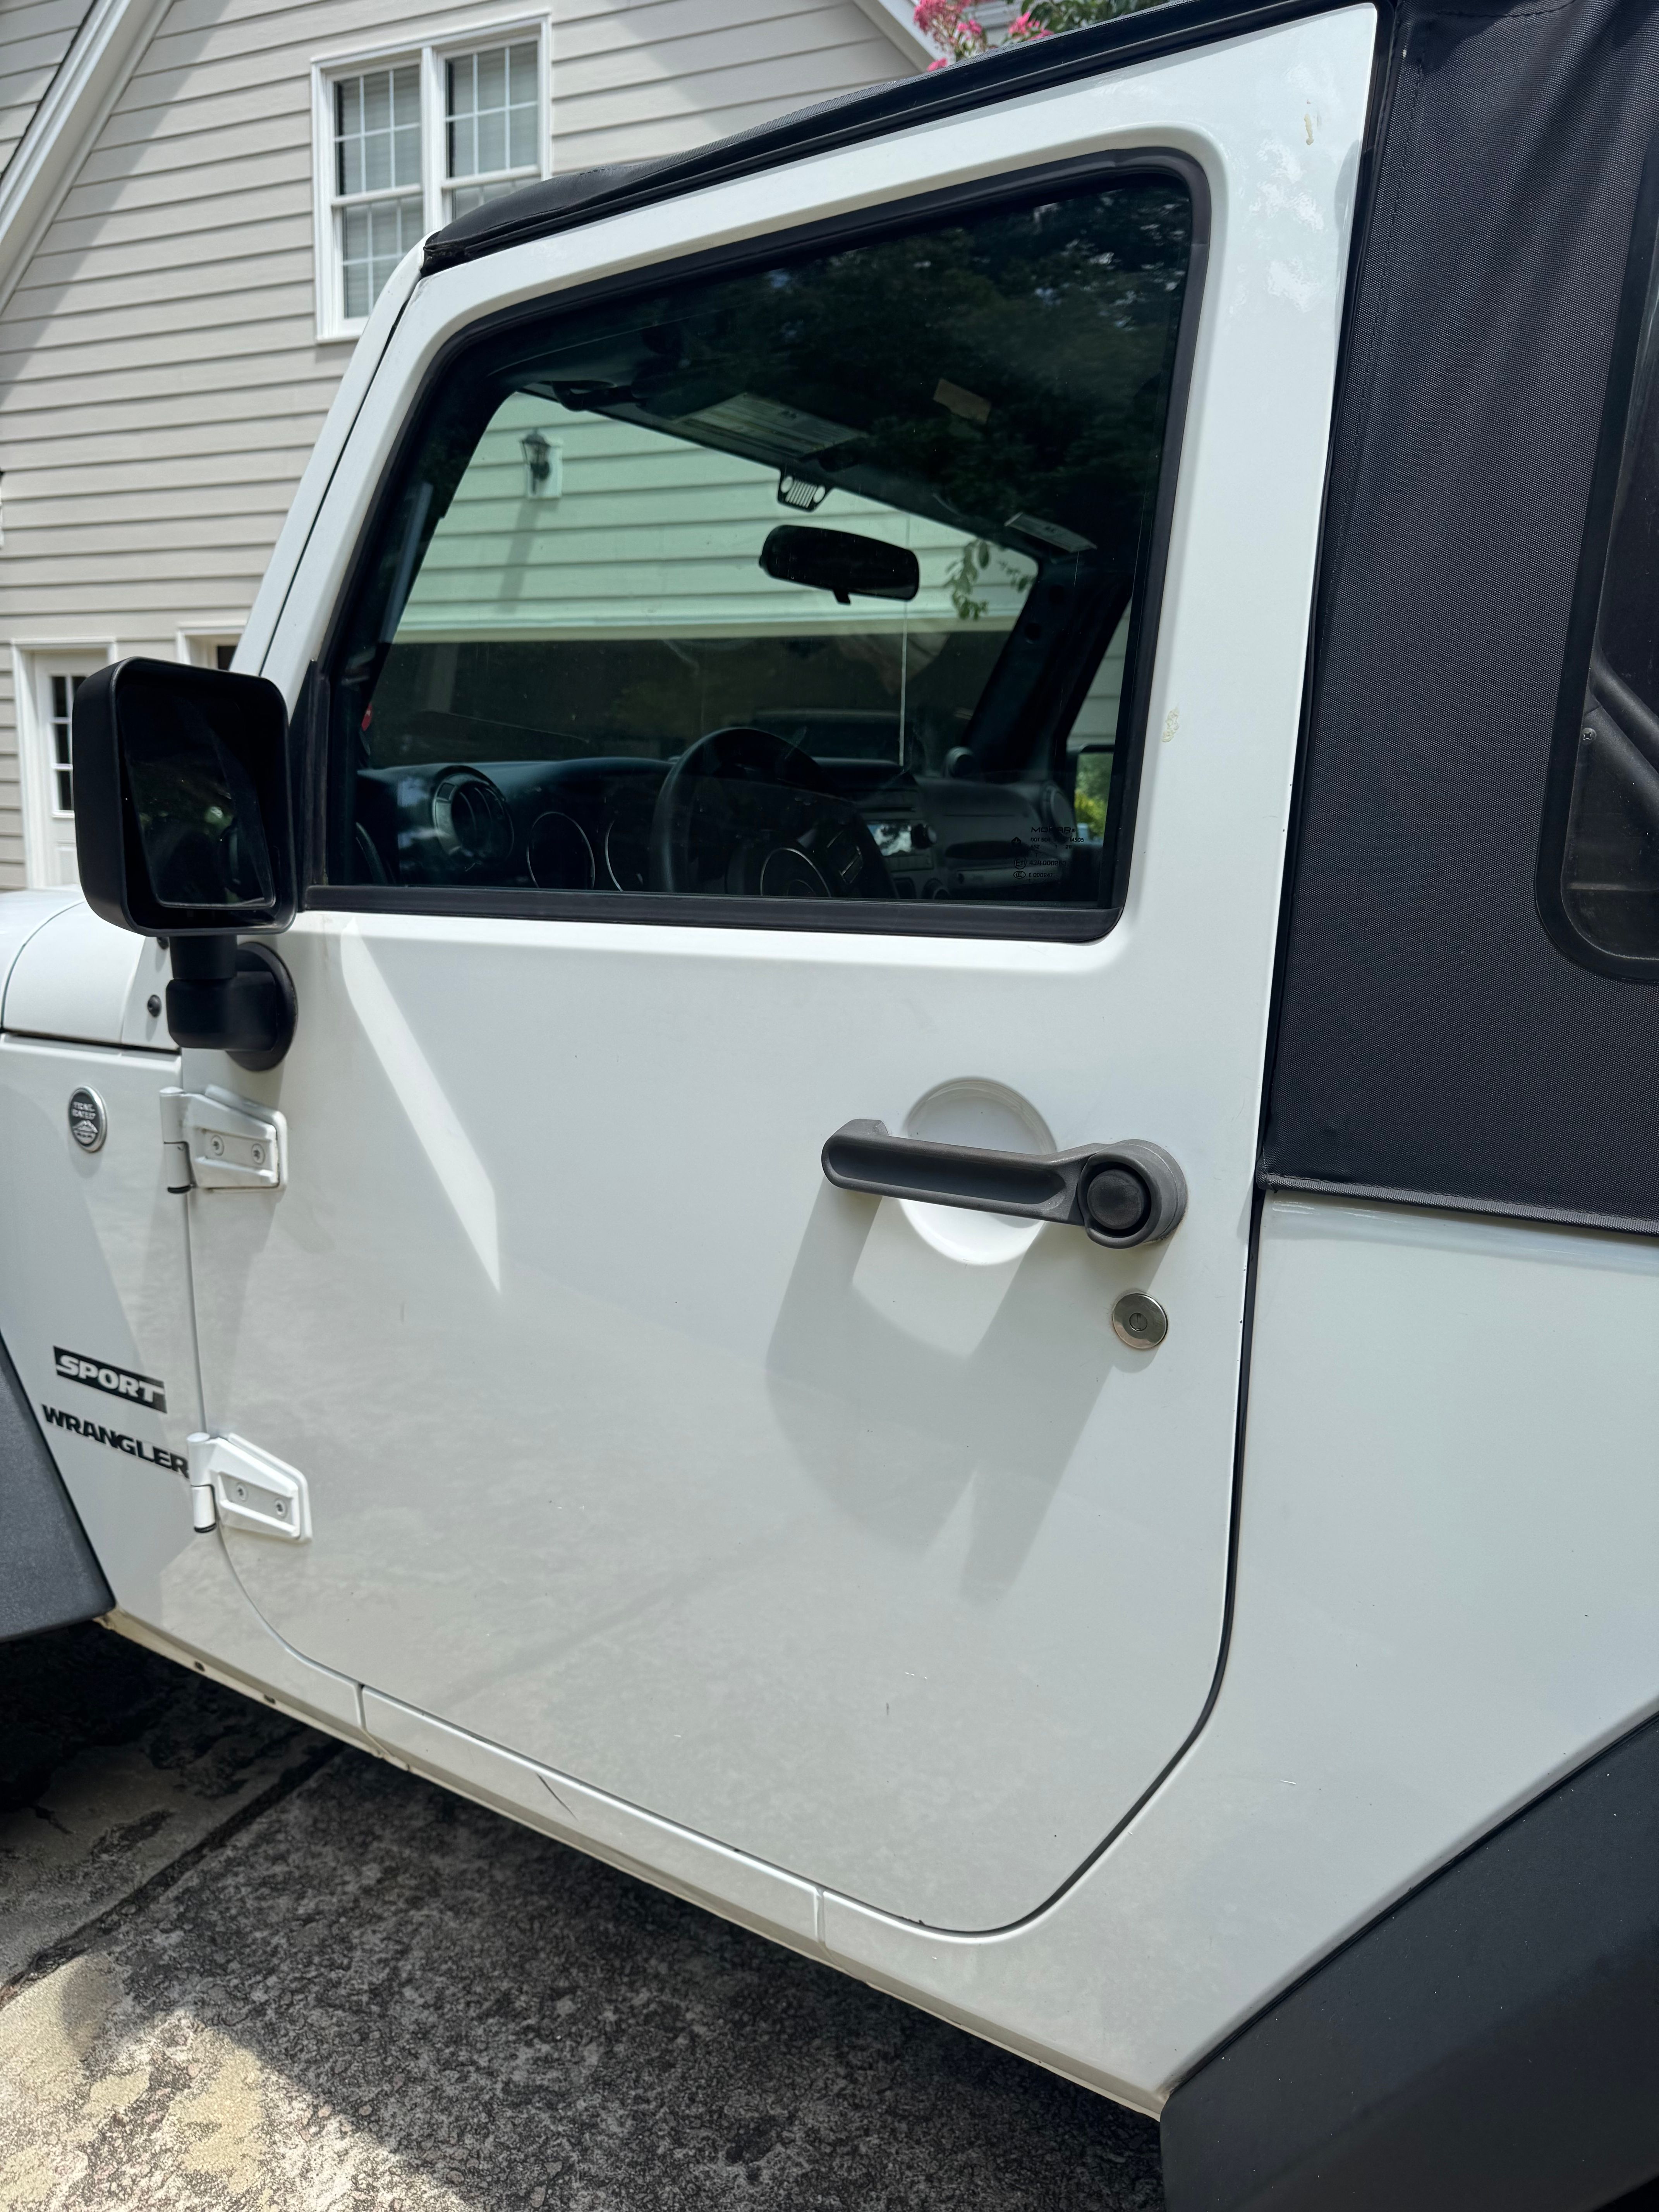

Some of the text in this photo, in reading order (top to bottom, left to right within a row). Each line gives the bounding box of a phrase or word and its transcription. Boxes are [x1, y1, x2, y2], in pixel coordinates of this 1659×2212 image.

[72, 1101, 96, 1112] TRAIL
[72, 1109, 96, 1120] RATED
[57, 1355, 165, 1403] SPORT
[41, 1404, 190, 1479] WRANGLER
